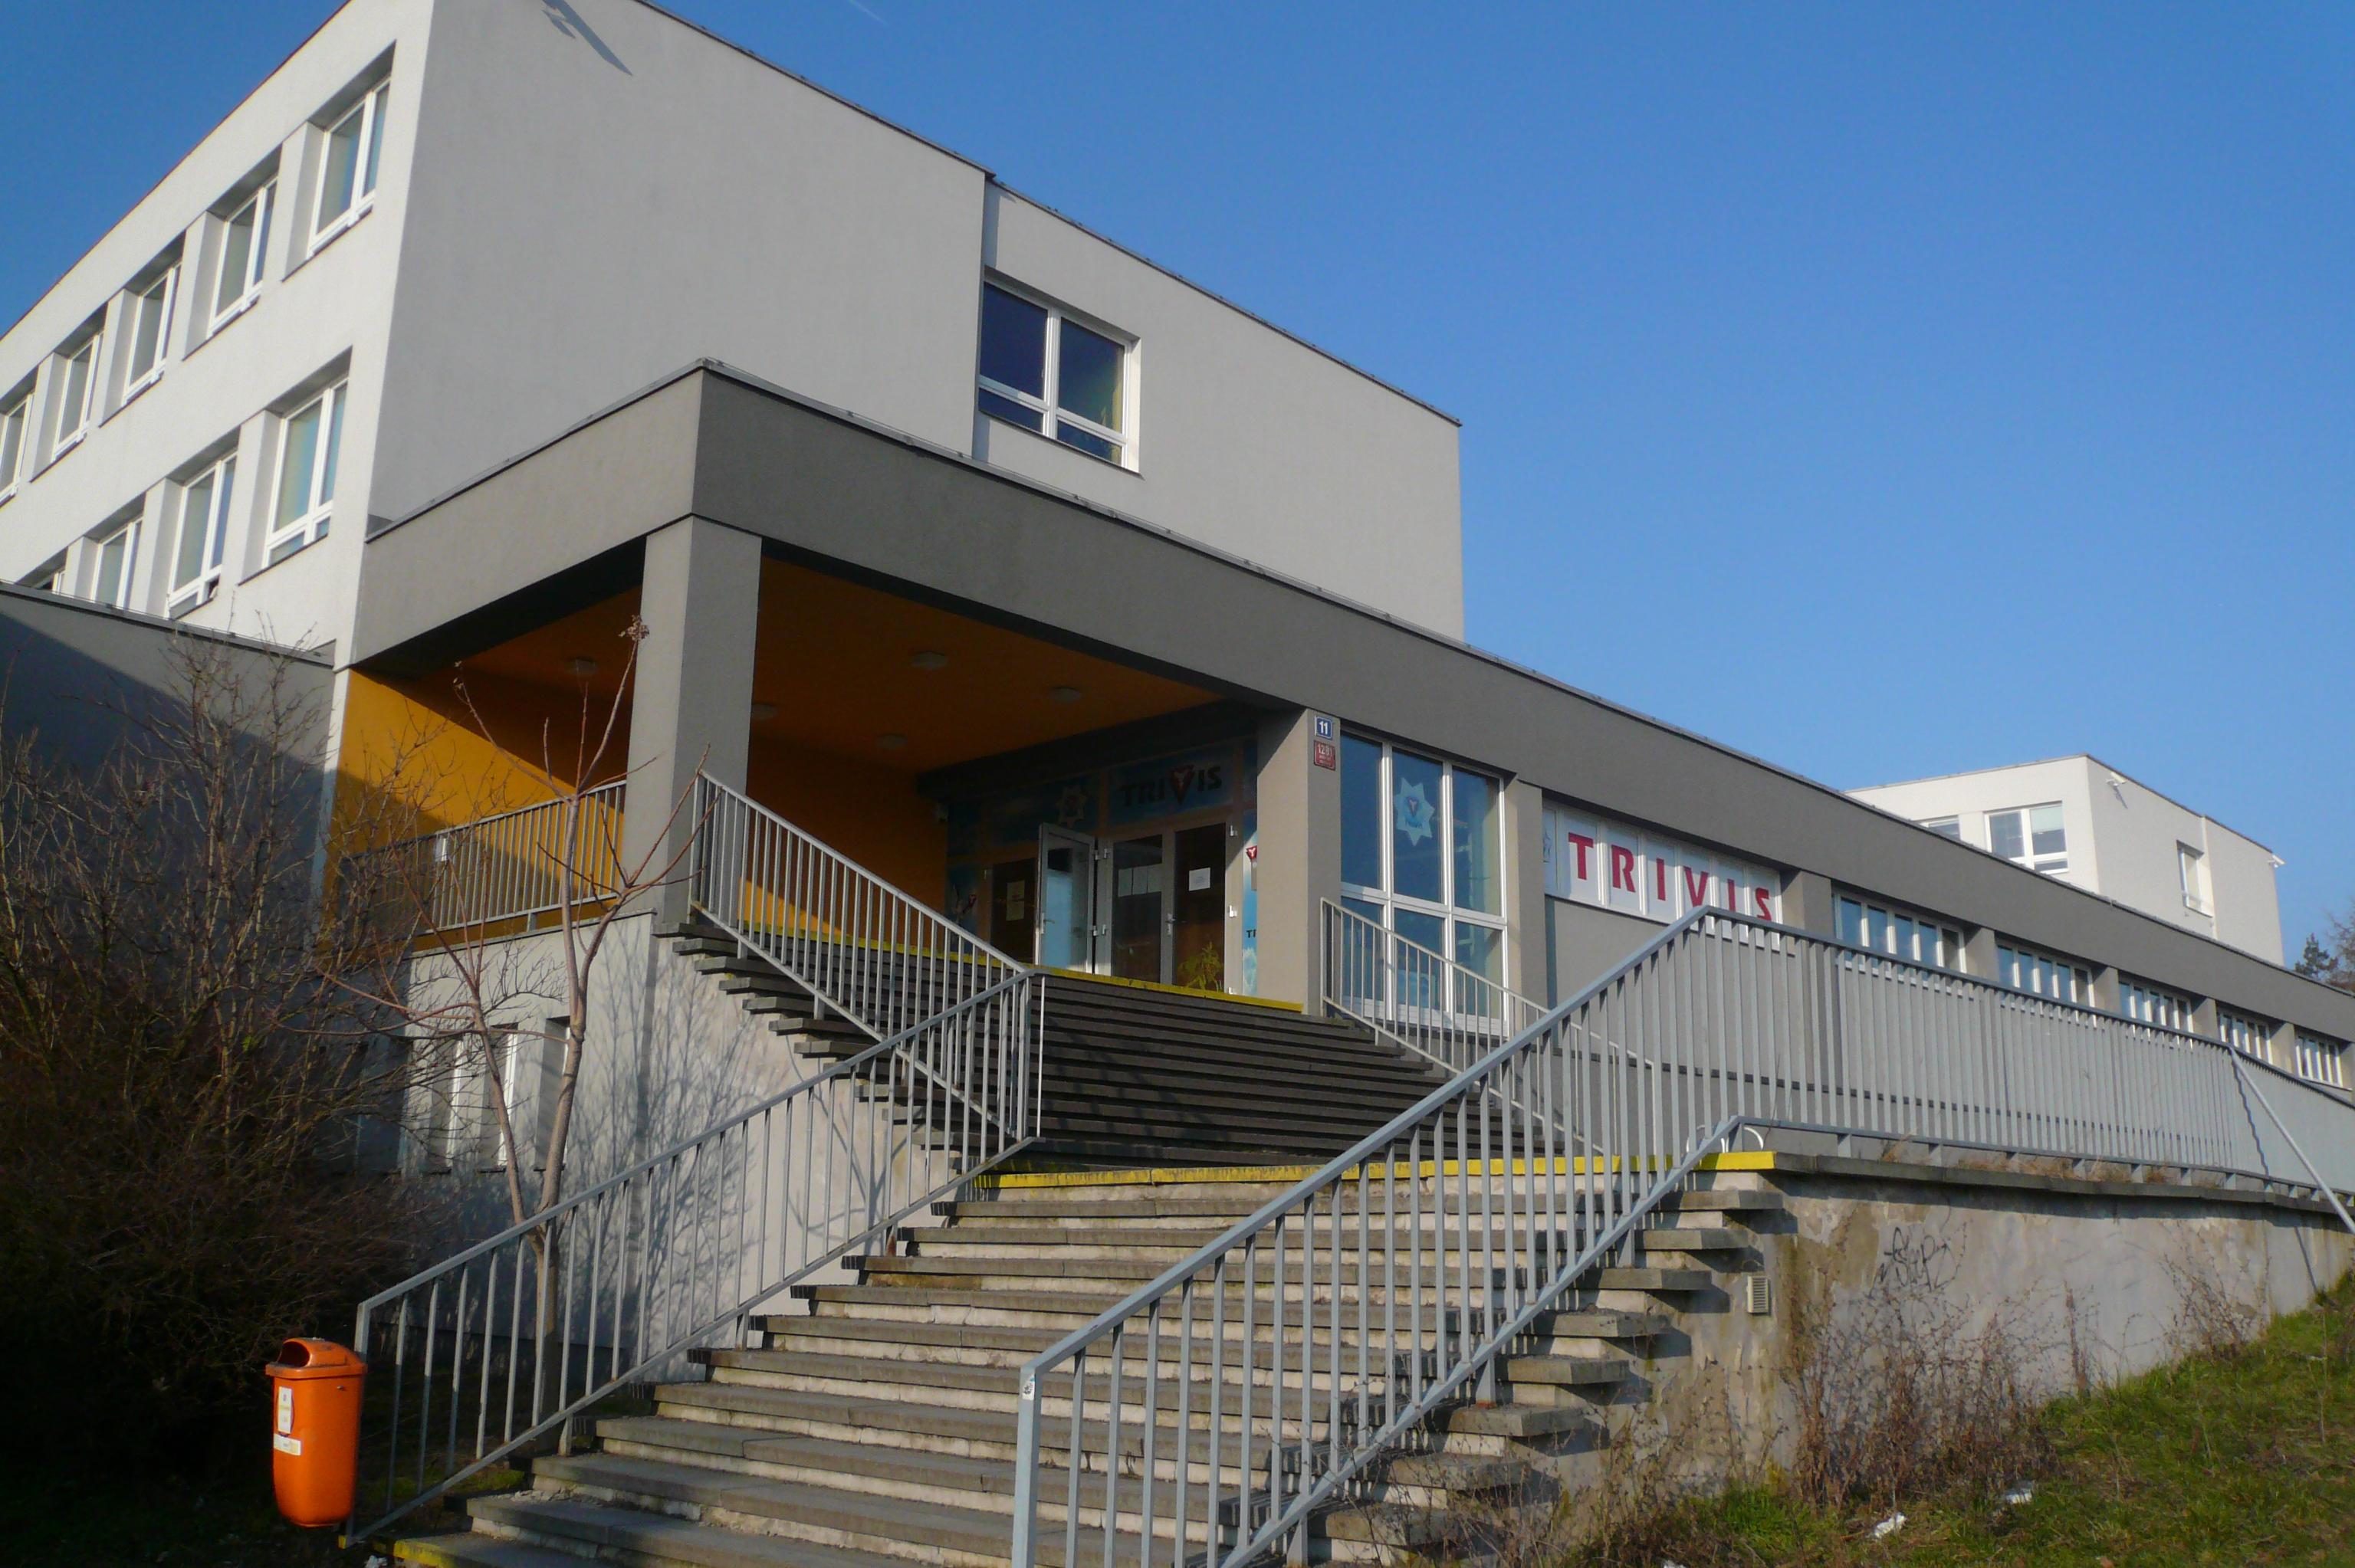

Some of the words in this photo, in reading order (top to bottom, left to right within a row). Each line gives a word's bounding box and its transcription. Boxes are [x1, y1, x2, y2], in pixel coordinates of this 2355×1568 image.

[1319, 720, 1329, 736] 11
[1119, 764, 1223, 807] TRIVIS
[1568, 832, 1772, 921] TRIVIS
